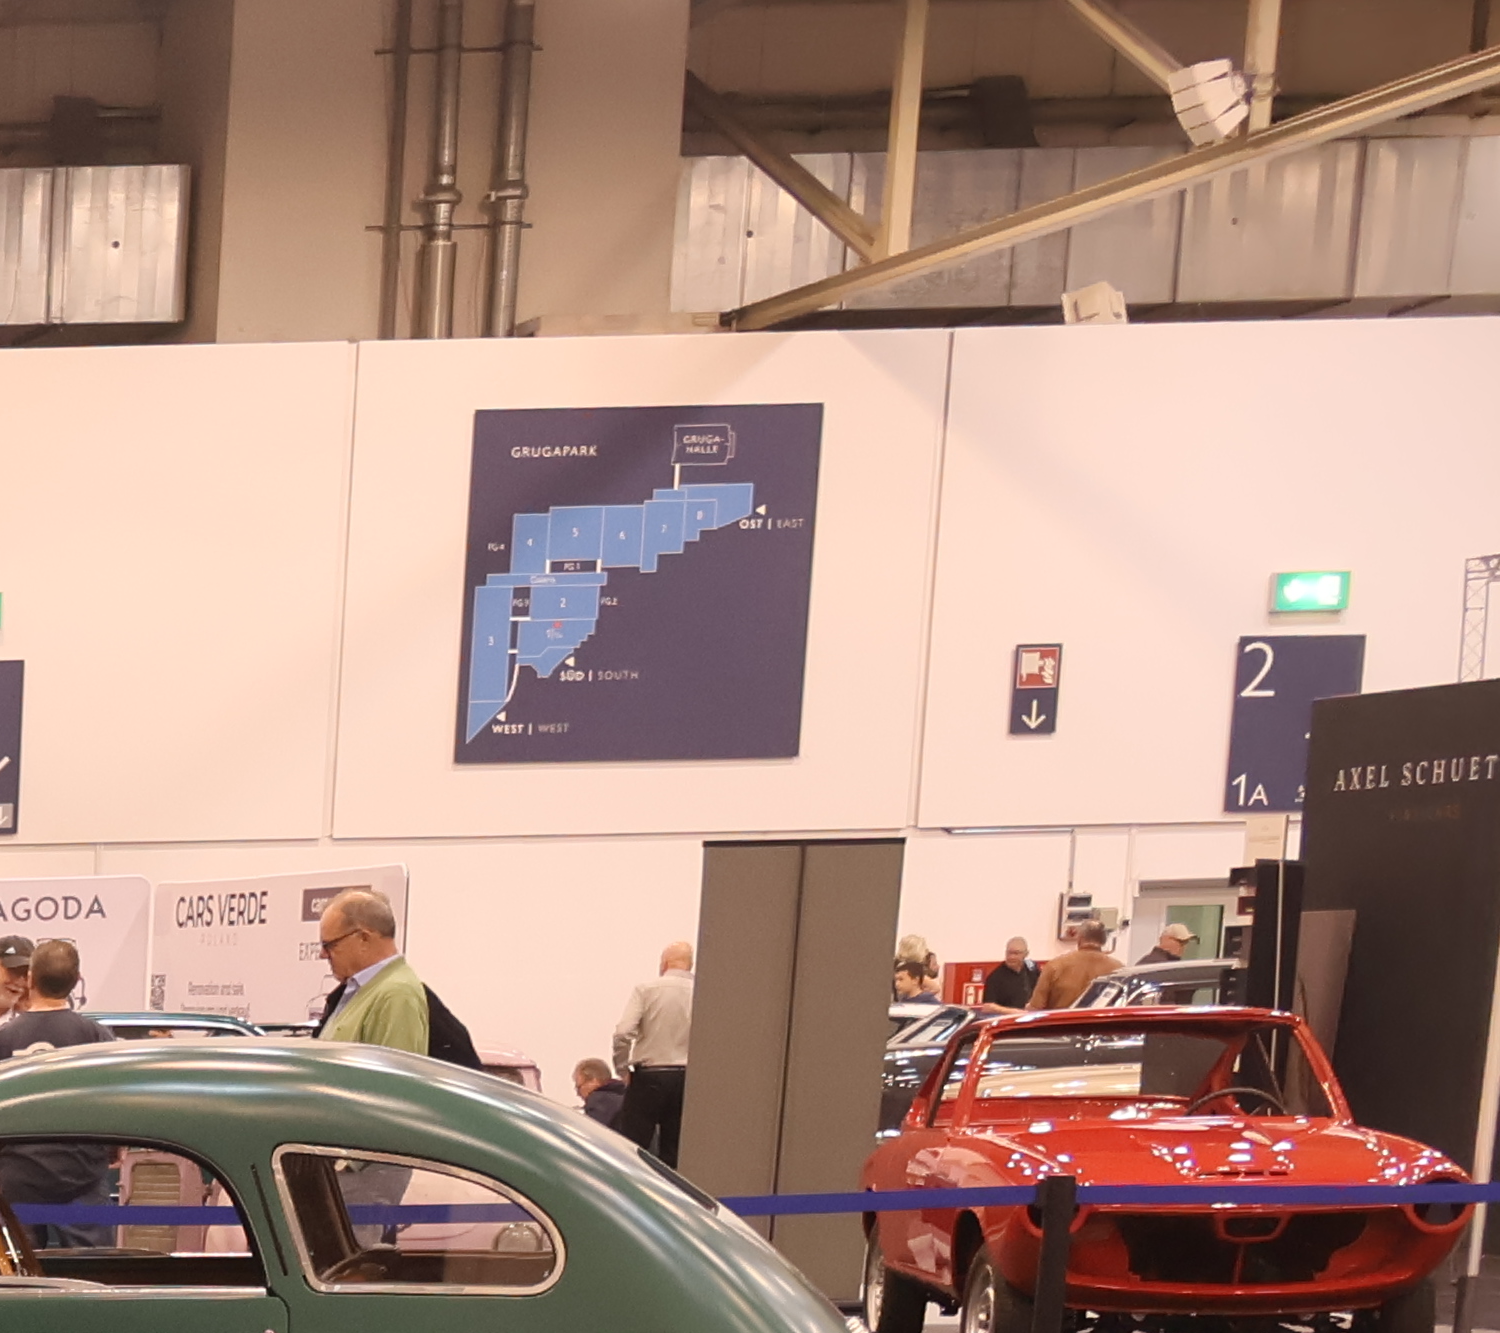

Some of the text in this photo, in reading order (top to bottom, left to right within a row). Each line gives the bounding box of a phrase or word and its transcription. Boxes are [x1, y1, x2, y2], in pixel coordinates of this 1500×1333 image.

[511, 444, 597, 459] GRUGAPARK
[739, 518, 804, 529] OST EAST
[560, 597, 566, 608] 2
[597, 670, 639, 681] SOUTH
[1240, 641, 1275, 697] 2
[491, 723, 570, 735] WEST WEST
[1333, 754, 1499, 792] AXEL SCHUET
[1231, 772, 1269, 807] 1A
[175, 891, 268, 928] CARS VERDE
